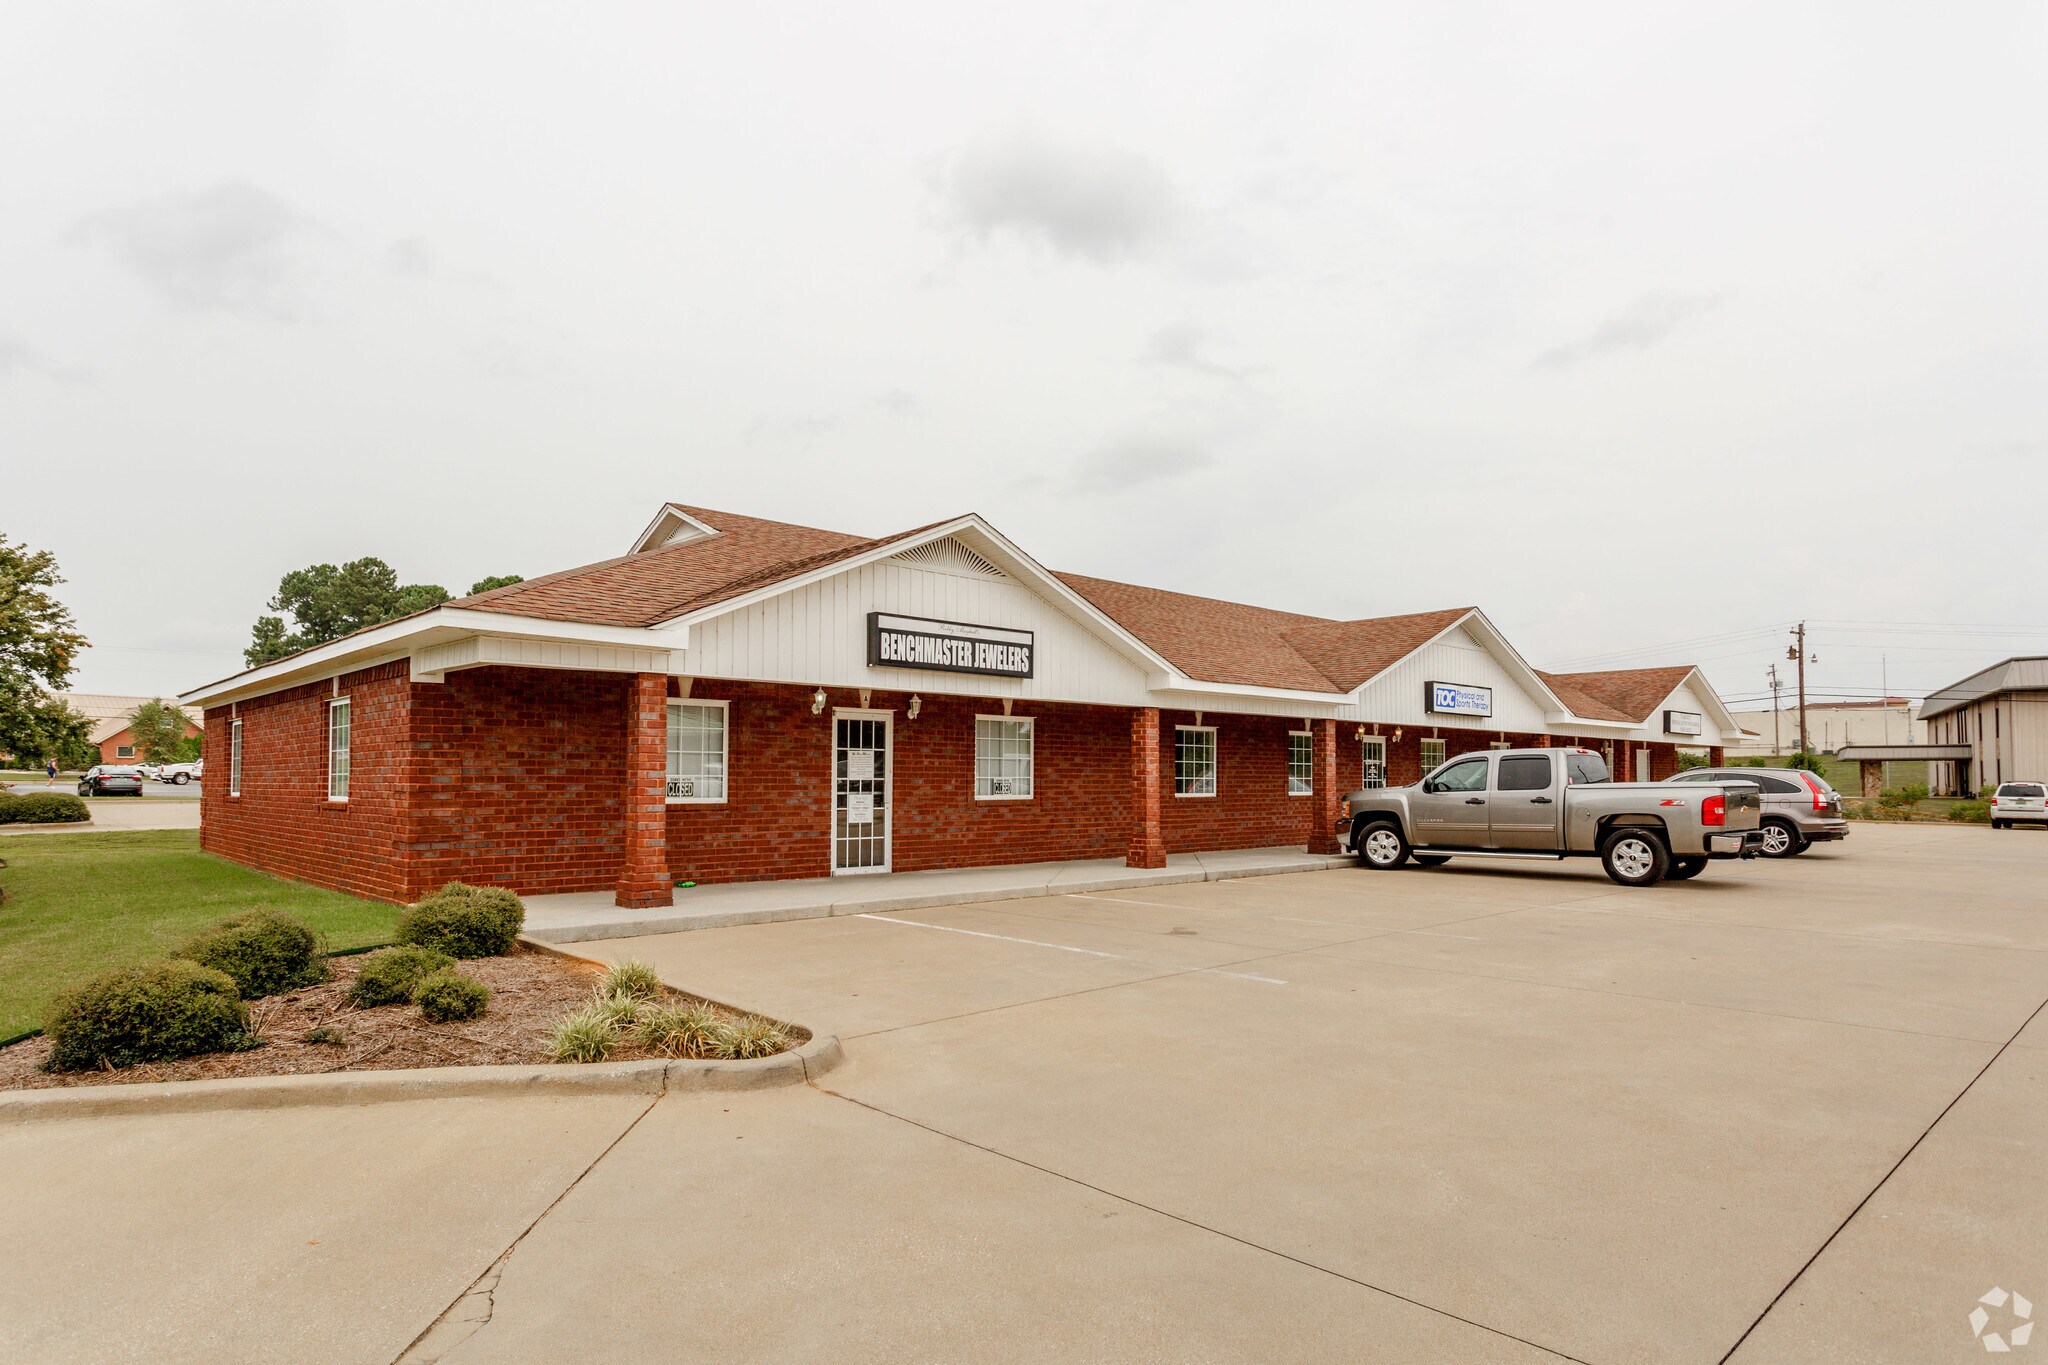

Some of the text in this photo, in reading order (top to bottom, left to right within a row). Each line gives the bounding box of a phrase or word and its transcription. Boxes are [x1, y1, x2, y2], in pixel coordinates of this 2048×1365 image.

[881, 632, 1029, 673] BENCHMASTER JEWELERS
[1437, 689, 1455, 706] TOC
[1456, 690, 1484, 701] Physical and
[1456, 699, 1489, 711] Sports Therapy
[667, 783, 693, 796] CLOSED
